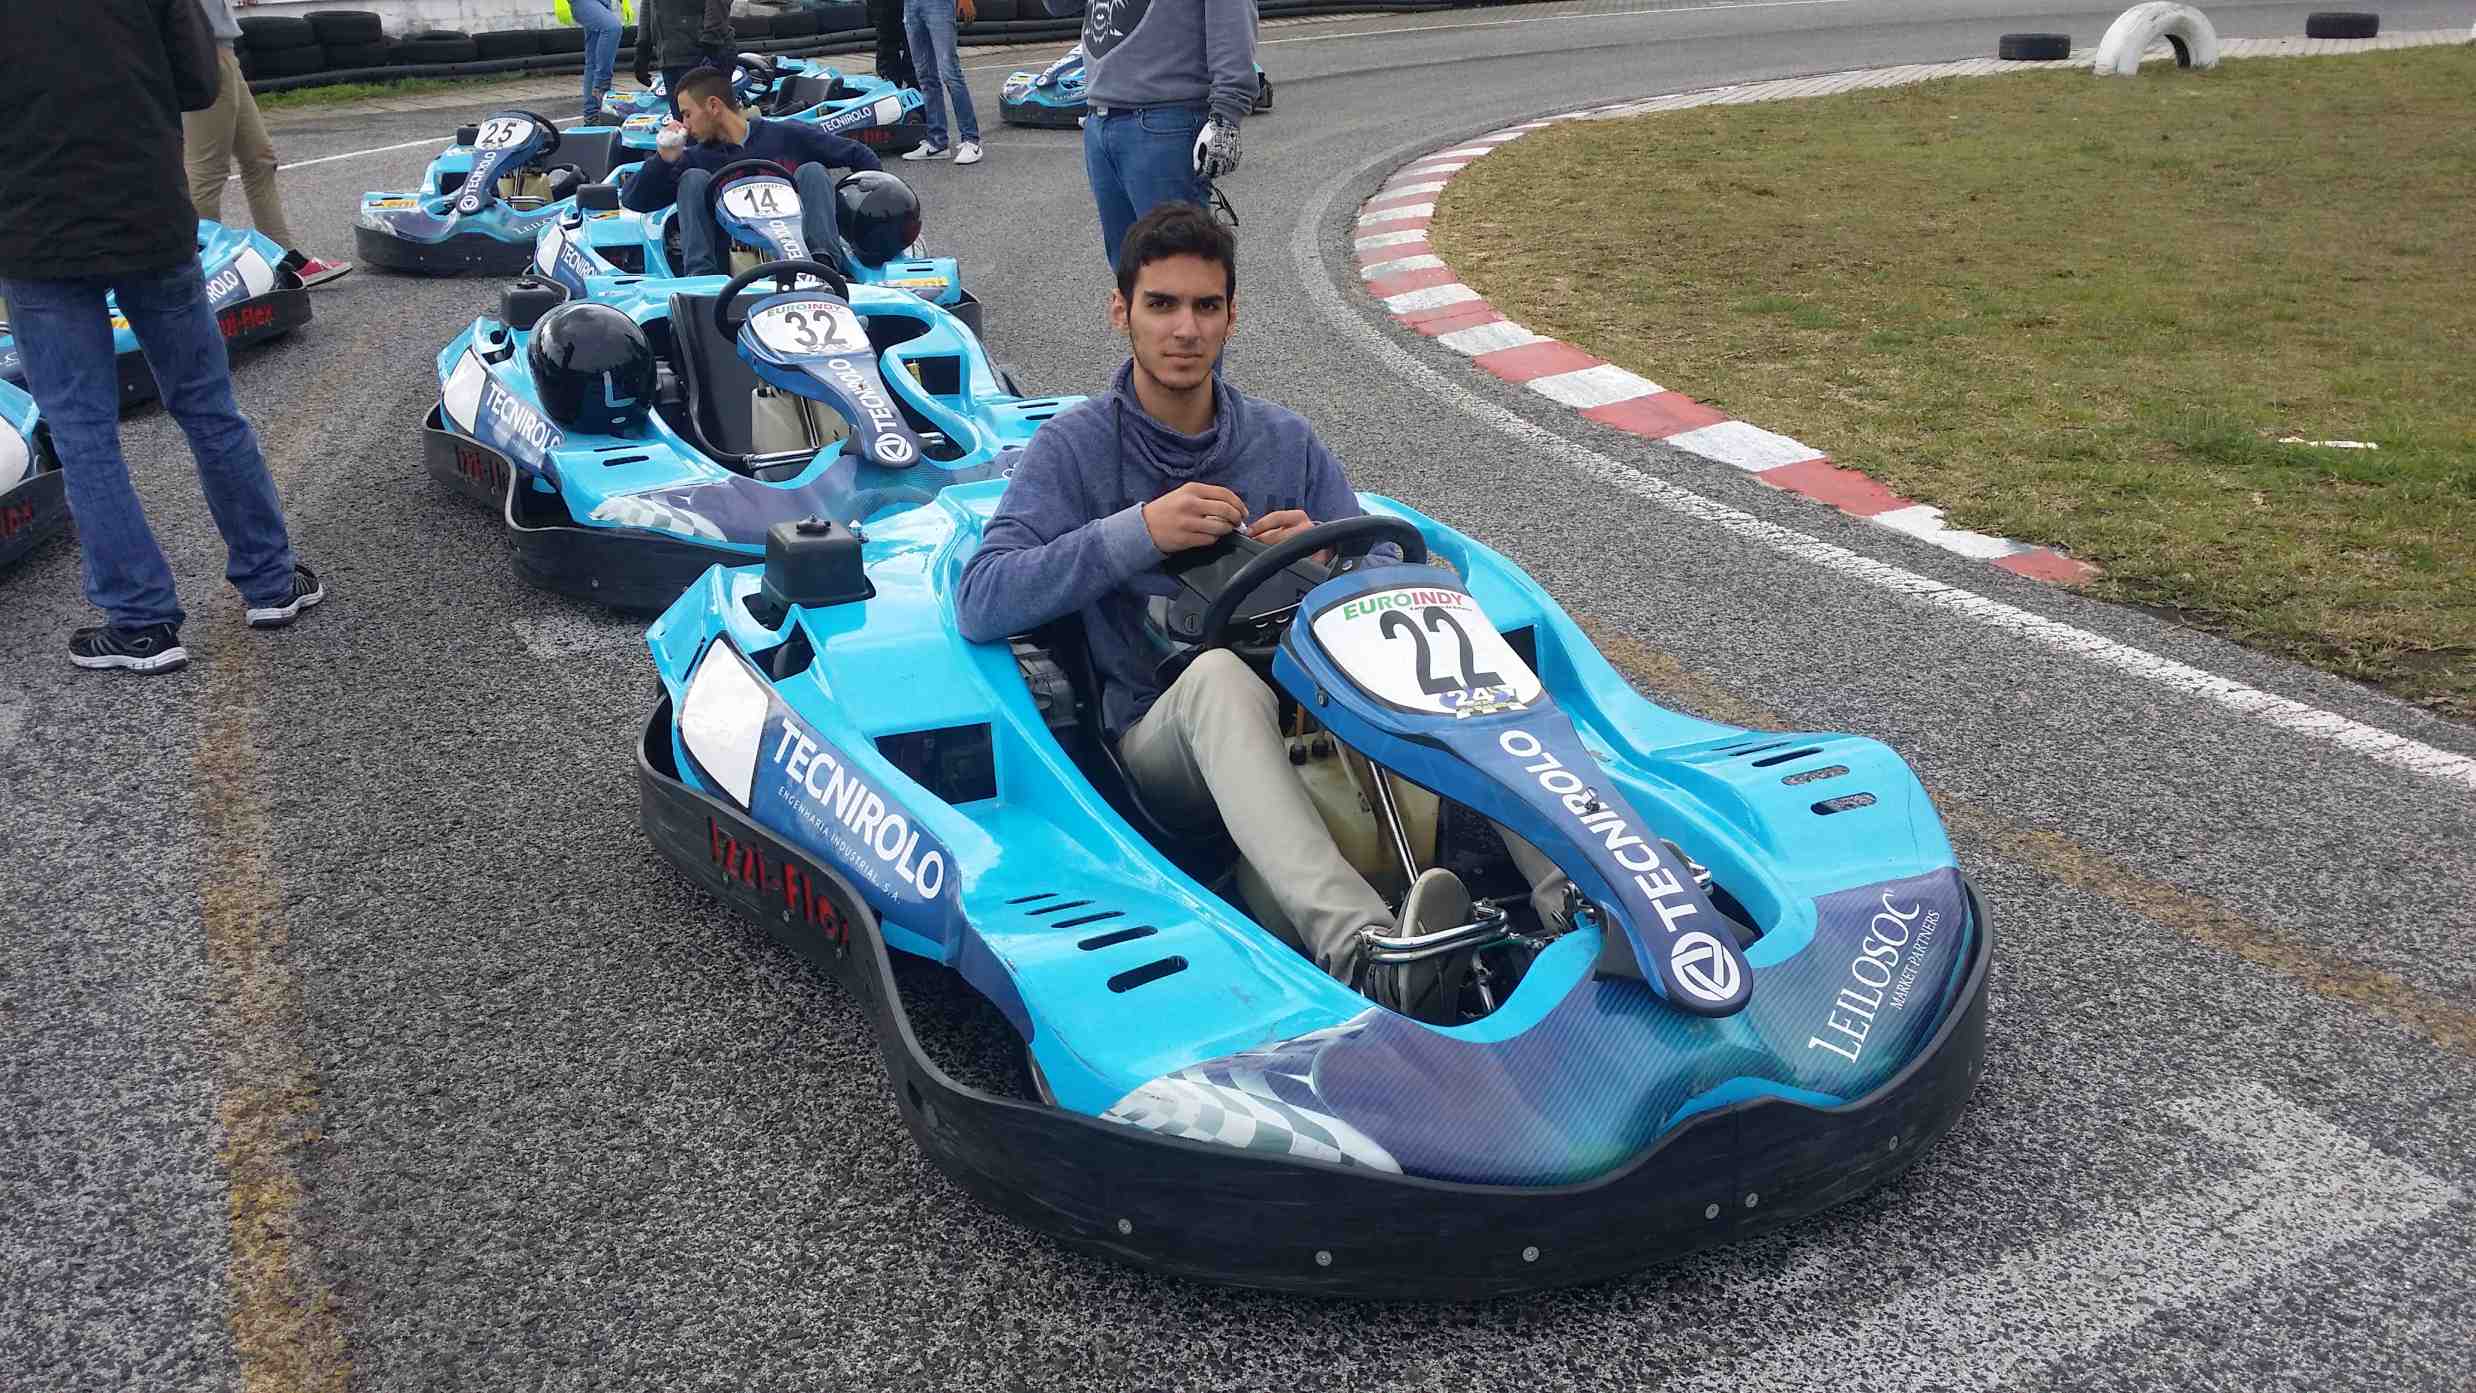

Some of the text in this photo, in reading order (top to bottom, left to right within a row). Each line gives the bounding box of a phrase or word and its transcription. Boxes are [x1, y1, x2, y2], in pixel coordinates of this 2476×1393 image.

[482, 122, 517, 144] 25
[820, 106, 872, 133] TECNIROLO
[744, 188, 778, 213] 14
[561, 242, 600, 280] TECNIRO
[767, 303, 841, 317] EUROINDY
[785, 310, 848, 346] 32
[1343, 590, 1464, 621] EUROINDY
[1379, 606, 1505, 695] 22
[773, 717, 944, 899] TECNIROLO
[777, 785, 830, 836] ENGENHARIA
[1499, 729, 1698, 933] TECNIROLO
[1808, 891, 1920, 1064] LEILOSOC
[1889, 909, 1942, 1011] MARKET PARTNERS
